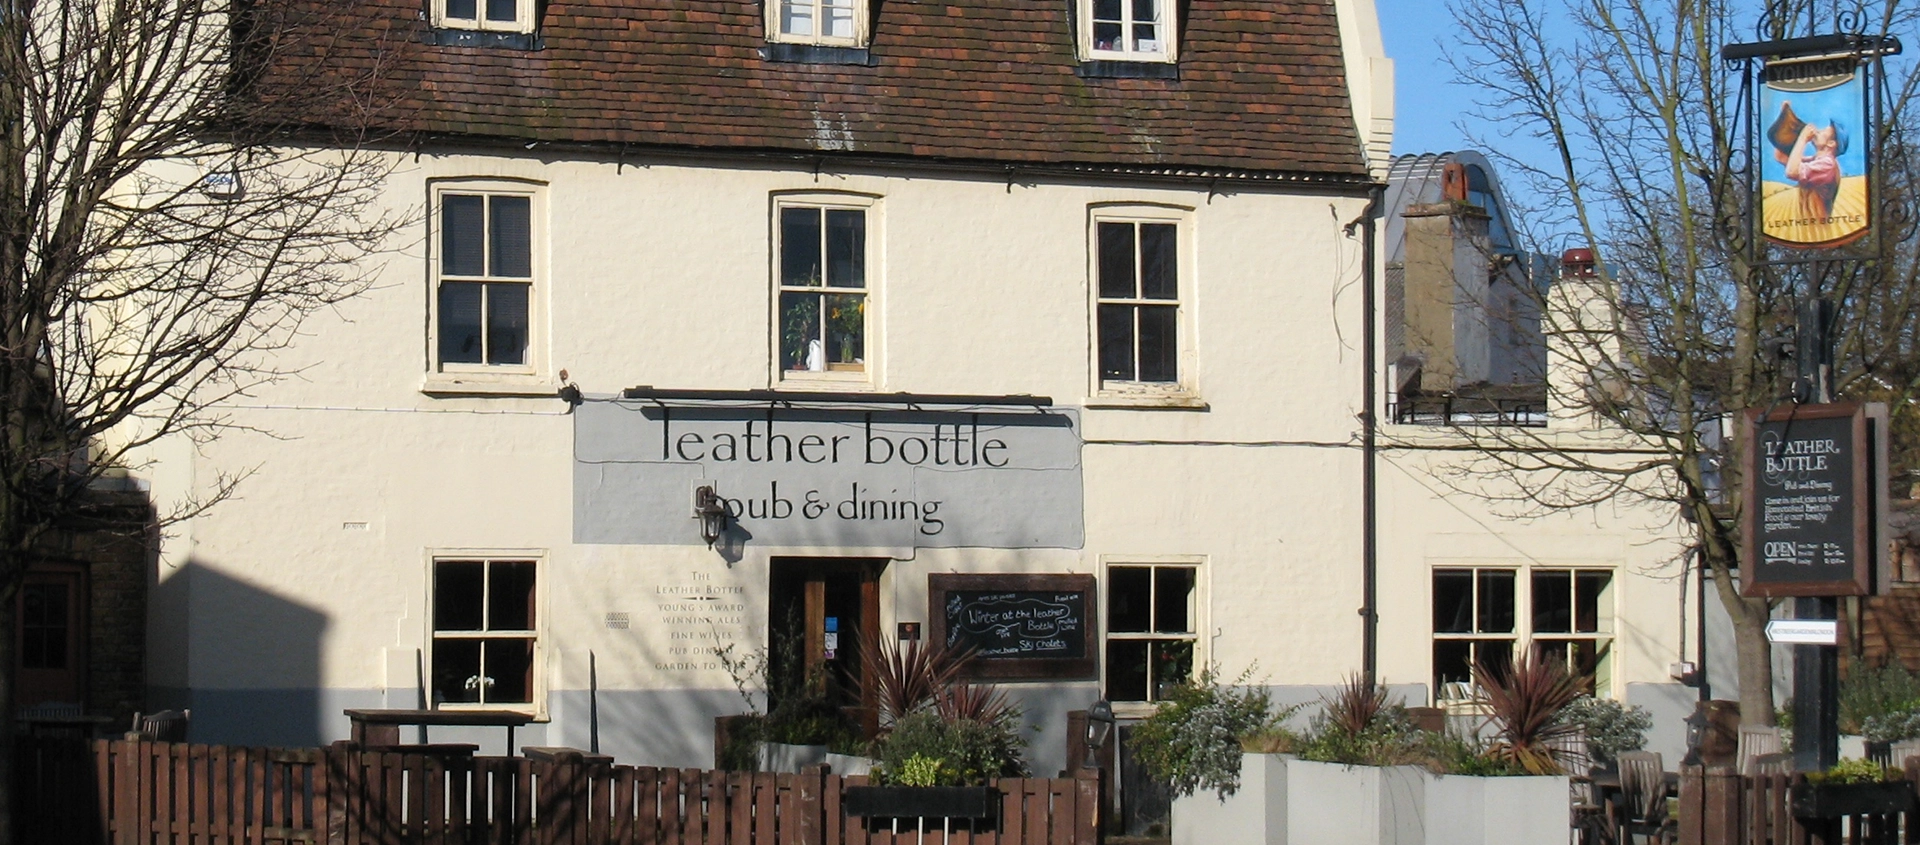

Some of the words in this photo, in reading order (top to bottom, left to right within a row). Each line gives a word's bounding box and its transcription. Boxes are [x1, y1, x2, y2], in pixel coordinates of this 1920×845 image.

[1768, 217, 1816, 229] LEATHER
[1819, 214, 1862, 224] BOTTLE
[663, 408, 850, 463] leather
[865, 411, 1009, 467] bottle
[1765, 439, 1840, 455] LATHER
[1765, 455, 1828, 473] BOTTLE
[721, 480, 794, 531] pub
[802, 490, 830, 519] &
[837, 482, 944, 535] dining
[1764, 541, 1796, 557] OPEN
[656, 585, 700, 594] LEATHER
[706, 585, 744, 594] BOTTLE
[708, 603, 744, 612] AWARD
[969, 610, 999, 624] Winter
[1002, 611, 1014, 620] at
[1015, 609, 1031, 619] the
[1033, 608, 1065, 618] leather
[1027, 619, 1055, 630] Bottle
[671, 631, 694, 639] FINE
[669, 647, 687, 655] PUB
[655, 662, 698, 670] GARDEN
[703, 662, 716, 670] TO
